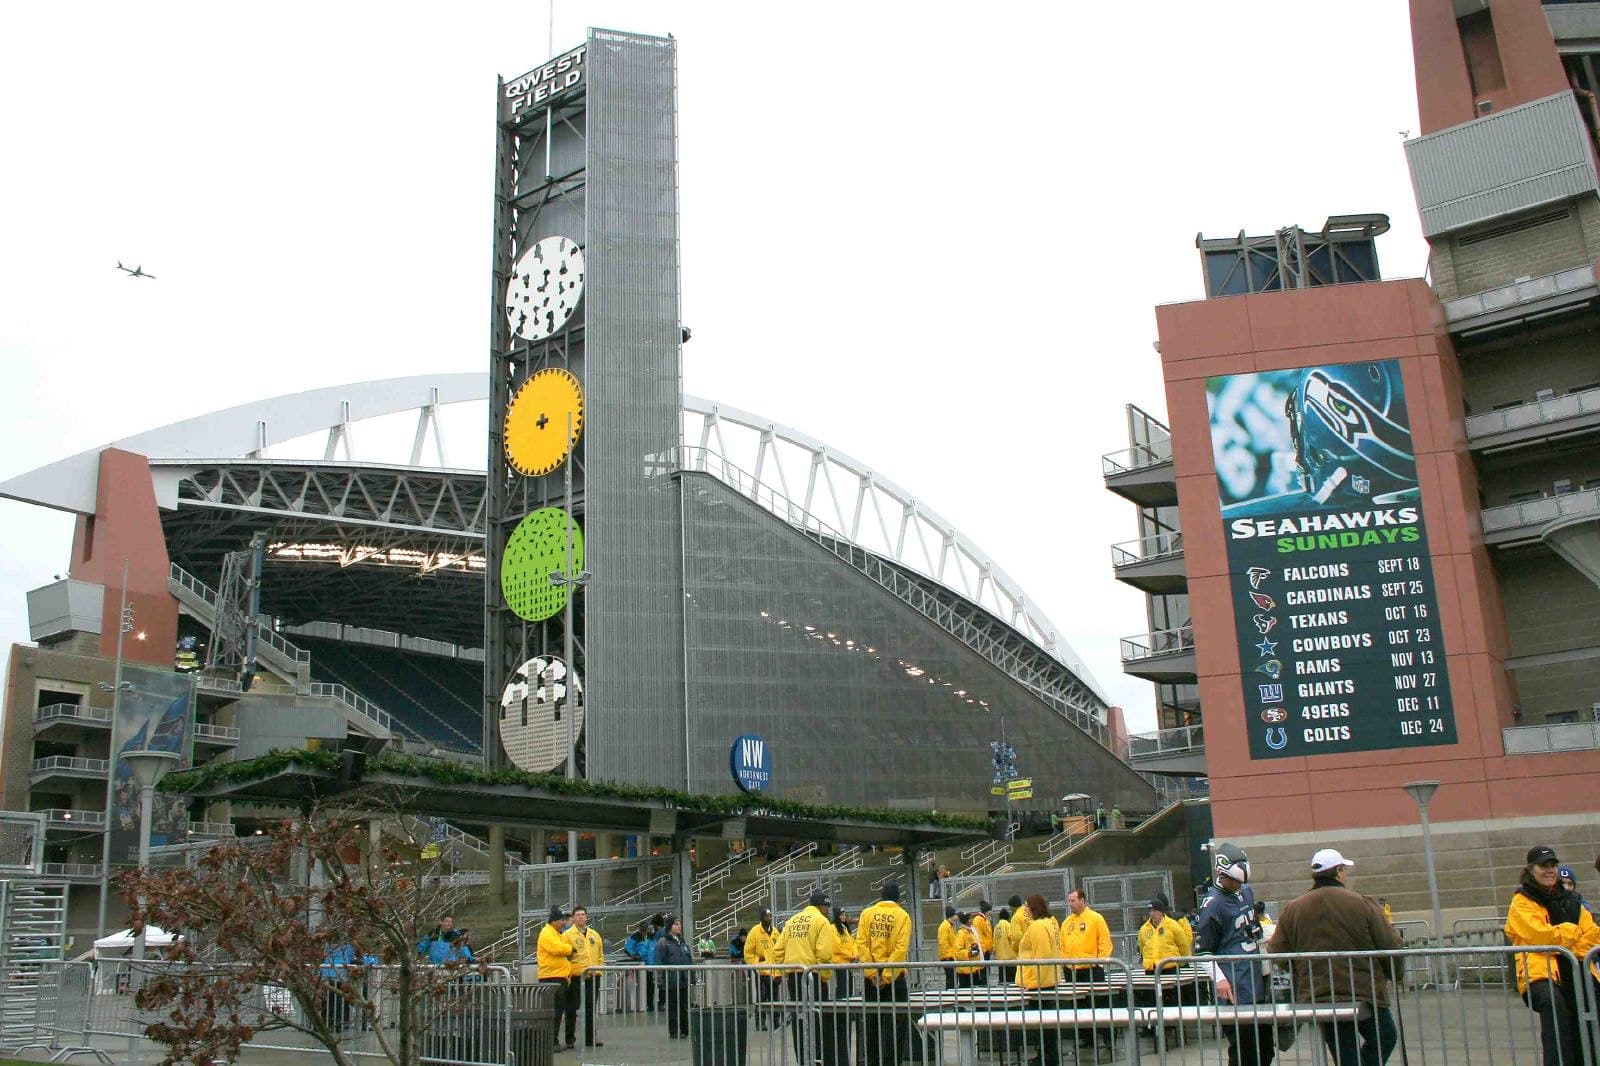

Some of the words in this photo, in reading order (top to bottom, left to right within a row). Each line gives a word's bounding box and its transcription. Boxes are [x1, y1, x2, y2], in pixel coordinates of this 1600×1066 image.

[505, 48, 586, 98] QWEST
[511, 70, 581, 115] FIELD
[1231, 507, 1419, 539] SEAHAWKS
[1276, 526, 1420, 553] SUNDAYS
[1284, 563, 1349, 582] FALCONS
[1378, 558, 1402, 574] SEPT
[1406, 557, 1420, 571] 18
[1286, 585, 1371, 606] CARDINALS
[1382, 582, 1405, 597] SEPT
[1409, 580, 1423, 594] 25
[1290, 610, 1348, 629] TEXANS
[1385, 606, 1406, 621] OCT
[1413, 604, 1427, 618] 16
[1292, 633, 1372, 653] COWBOYS
[1388, 630, 1409, 645] OCT
[1416, 628, 1430, 642] 23
[1296, 658, 1341, 675] RAMS
[1391, 653, 1413, 668] NOV
[1421, 651, 1434, 664] 13
[1298, 680, 1355, 698] GIANTS
[1394, 675, 1416, 690] NOV
[1423, 673, 1436, 687] 27
[1301, 703, 1350, 720] 49ERS
[1398, 698, 1419, 712] DEC
[1426, 696, 1440, 710] 11
[1304, 726, 1350, 743] COLTS
[1401, 720, 1422, 736] DEC
[1429, 718, 1444, 733] 24
[743, 738, 763, 768] NW
[740, 770, 768, 780] NORTHWEST
[788, 923, 812, 931] EVENT
[870, 922, 894, 932] EVENT
[874, 914, 894, 922] CSC
